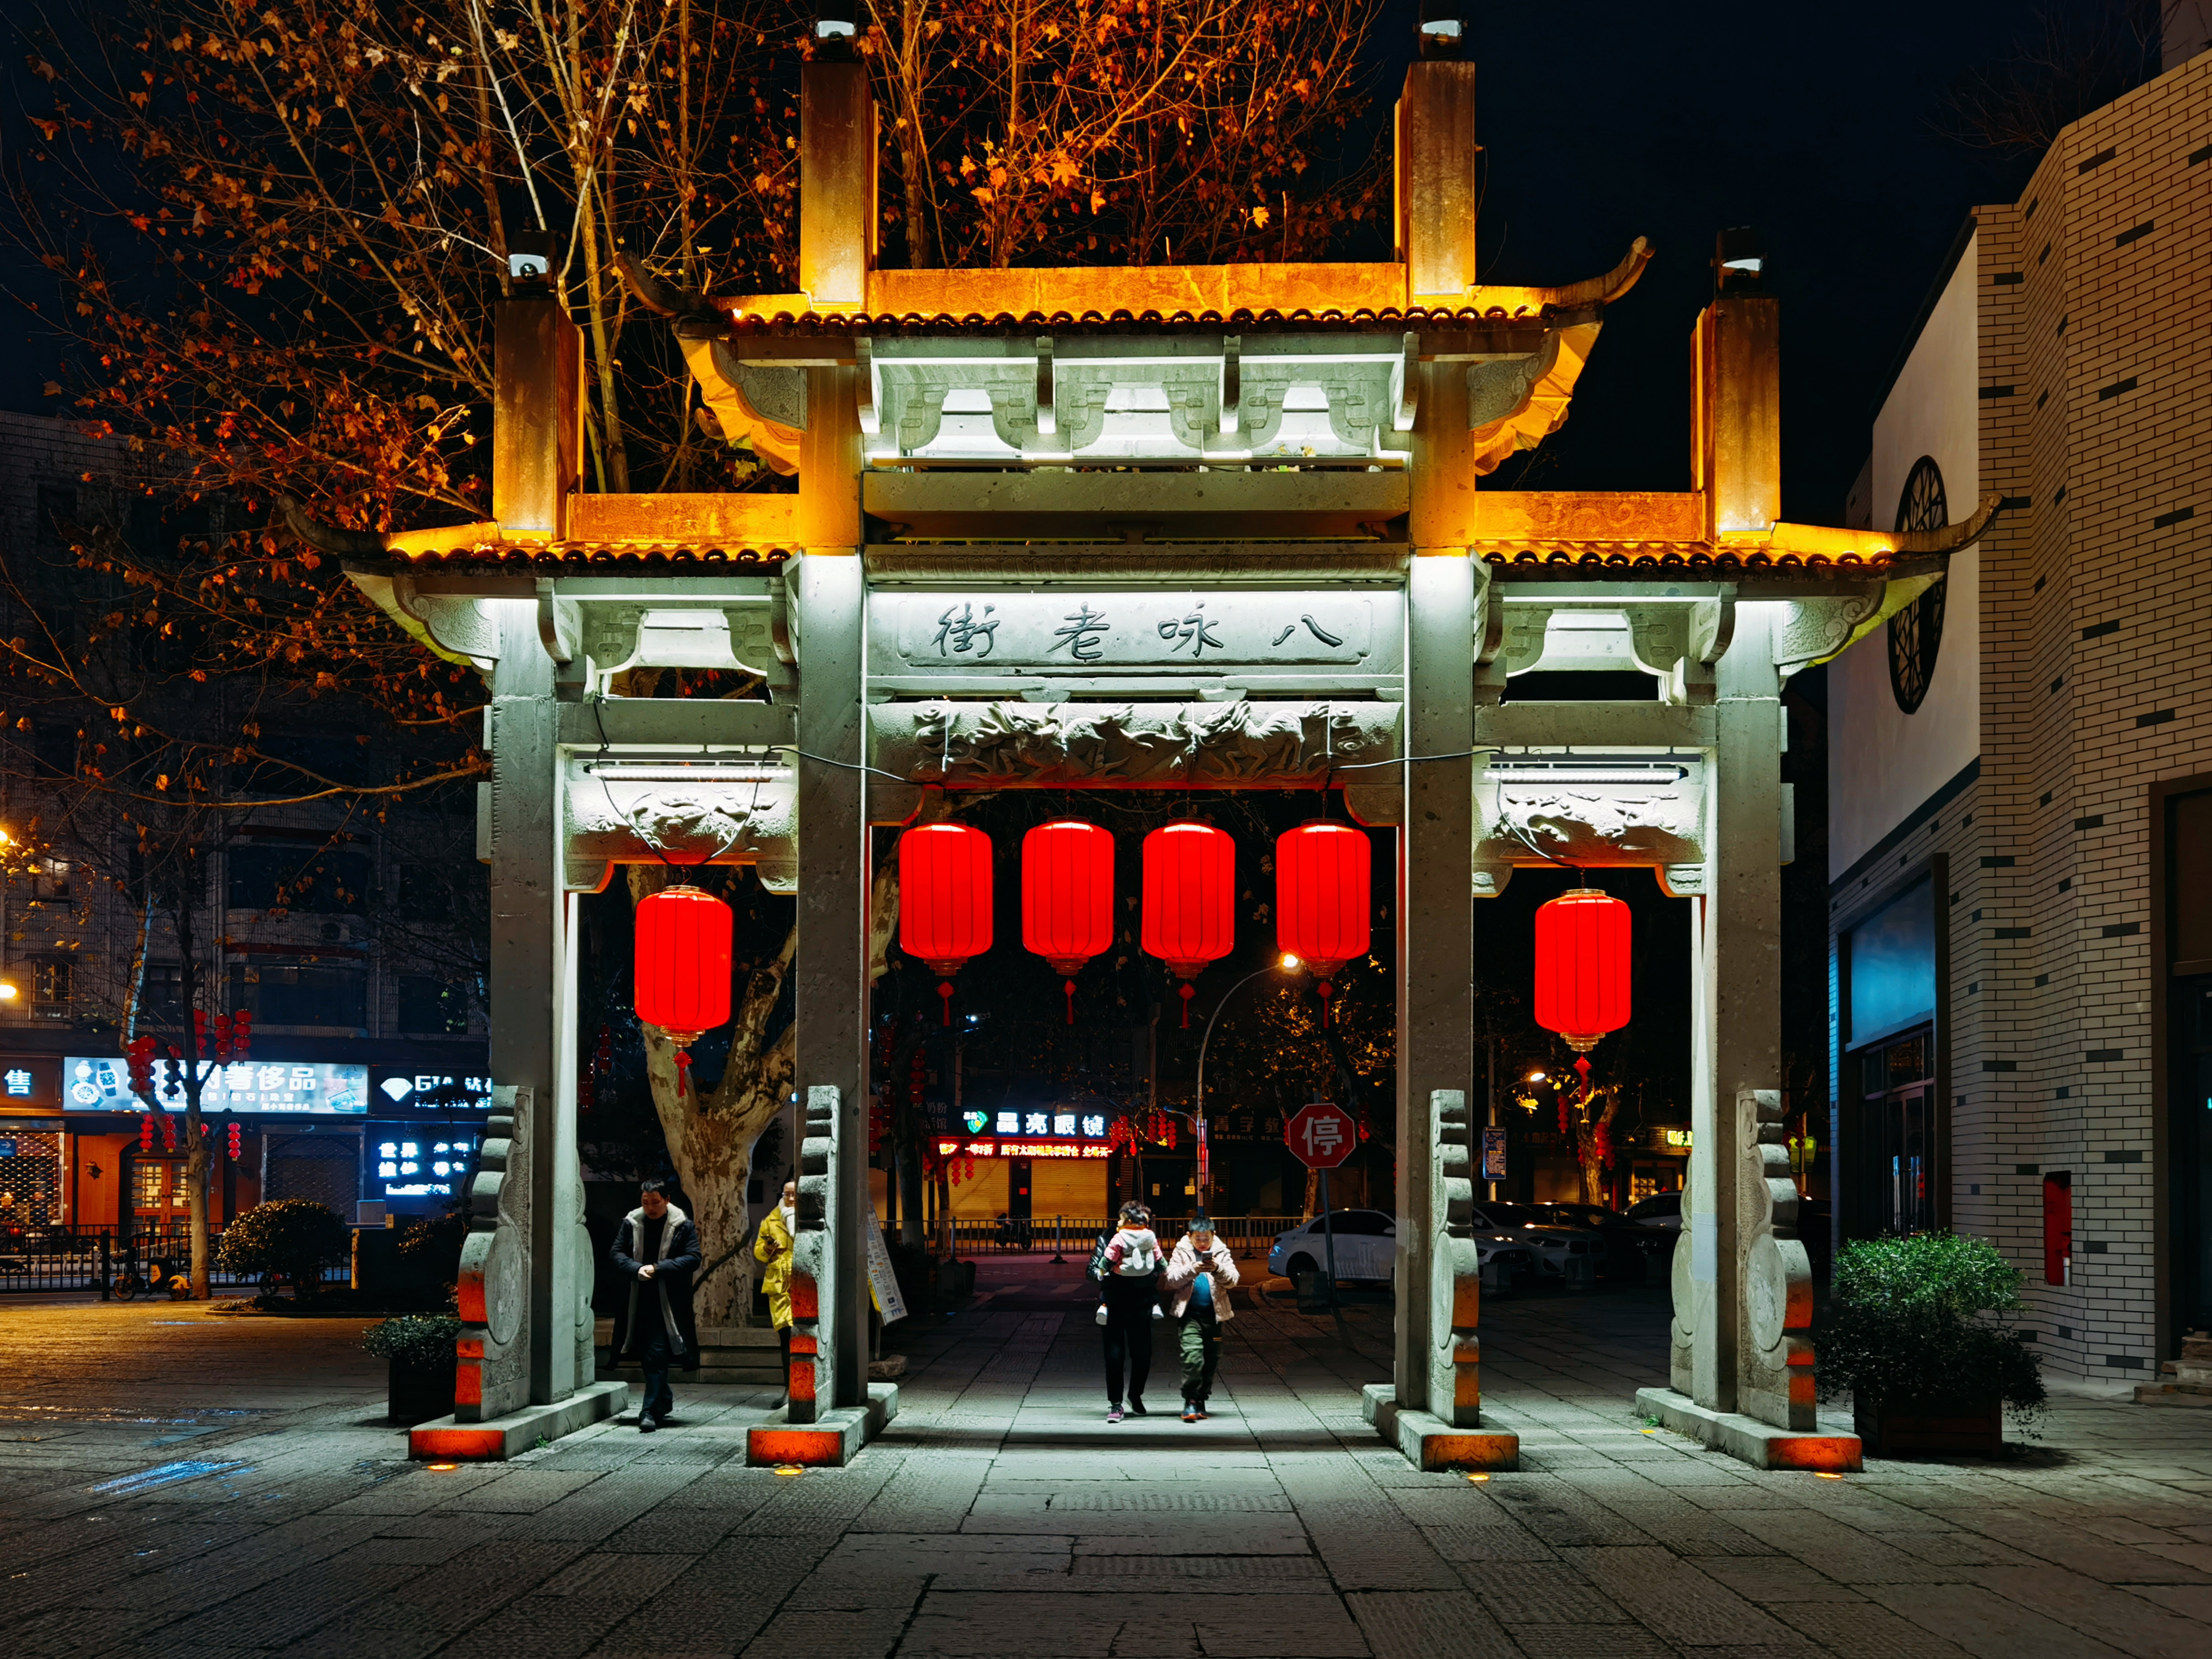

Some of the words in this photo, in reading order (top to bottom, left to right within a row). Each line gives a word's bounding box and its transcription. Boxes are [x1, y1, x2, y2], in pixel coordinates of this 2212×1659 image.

[930, 600, 1343, 660] 八咏老街
[4, 1069, 31, 1094] 售
[997, 1112, 1104, 1136] 晶亮眼镜
[1302, 1116, 1343, 1156] 停
[378, 1142, 418, 1158] 世界
